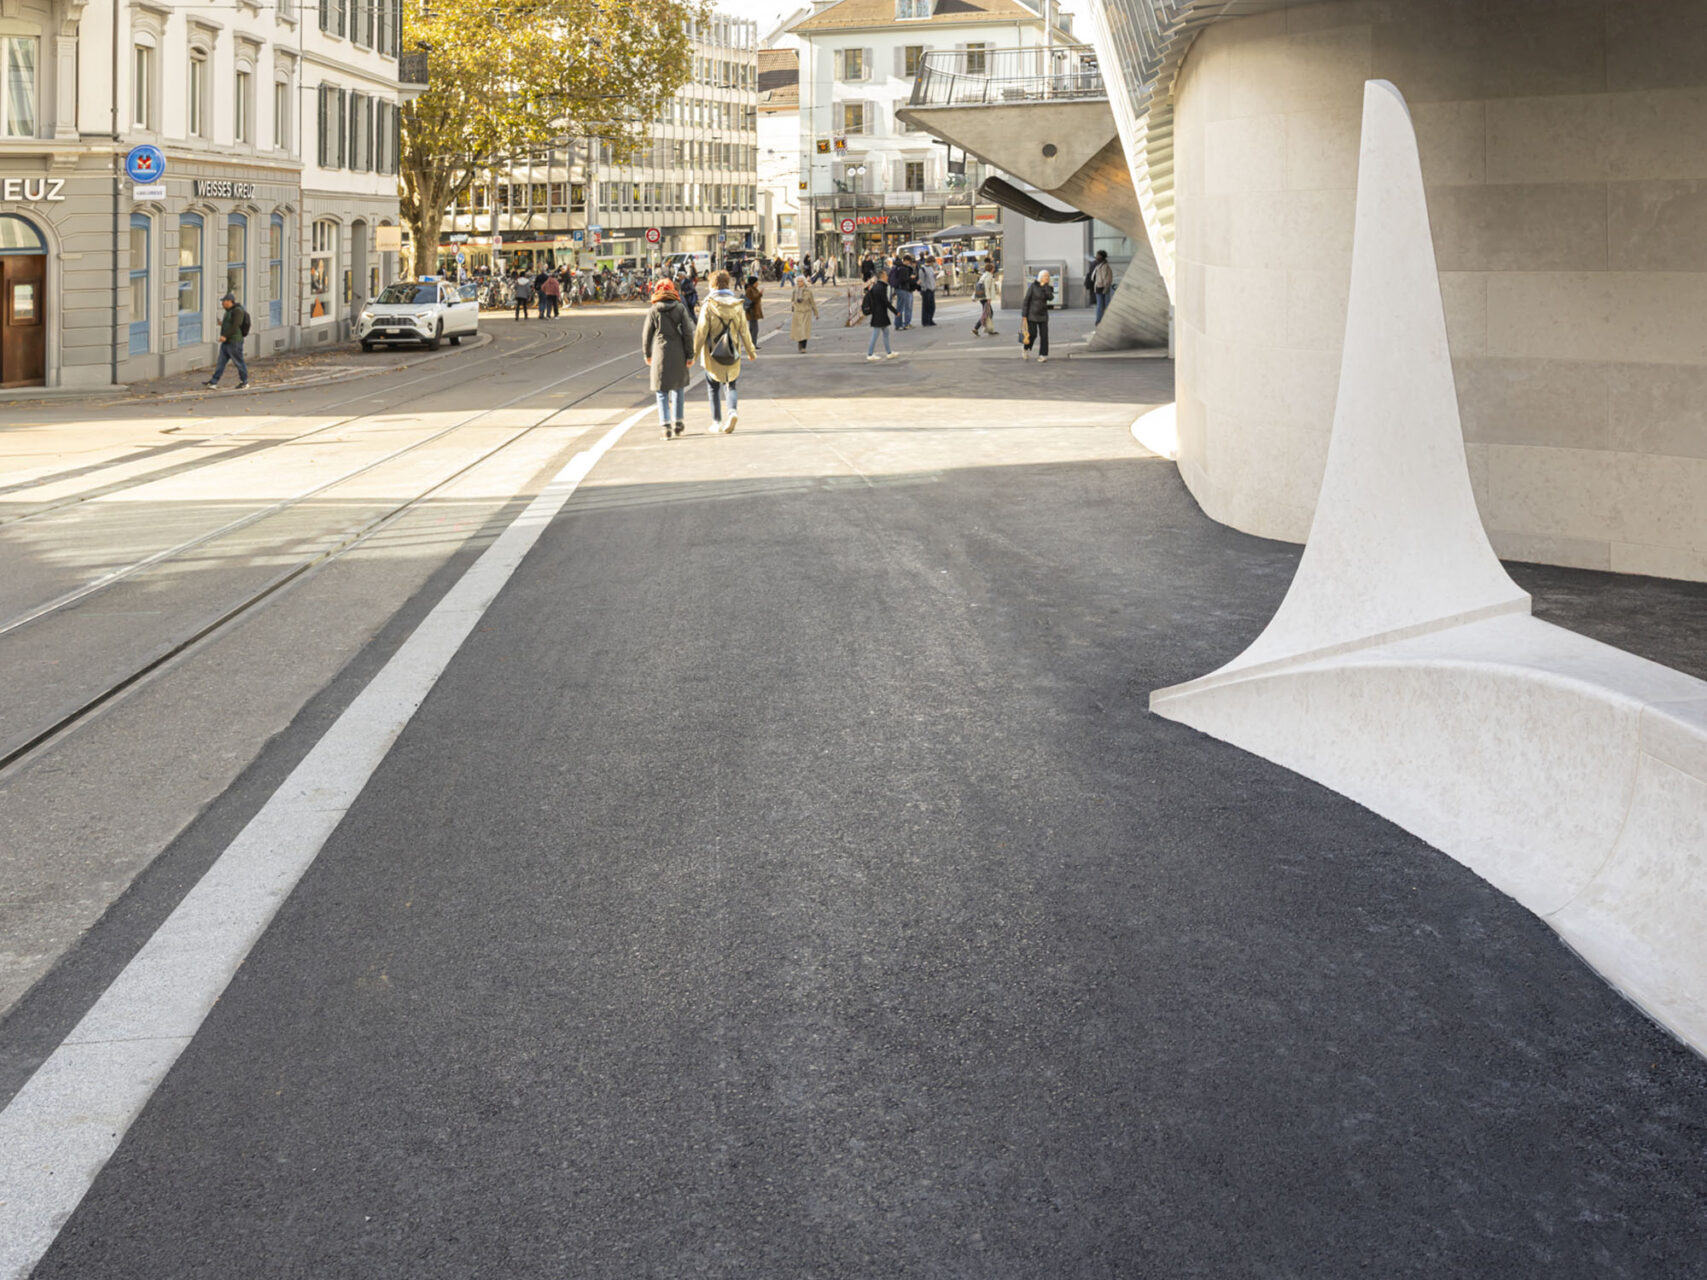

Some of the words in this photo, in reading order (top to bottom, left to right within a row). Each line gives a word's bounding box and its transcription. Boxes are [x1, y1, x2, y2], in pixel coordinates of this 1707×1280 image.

[4, 178, 65, 201] EUZ
[196, 179, 232, 198] WEISSES
[233, 182, 256, 199] KREUZ
